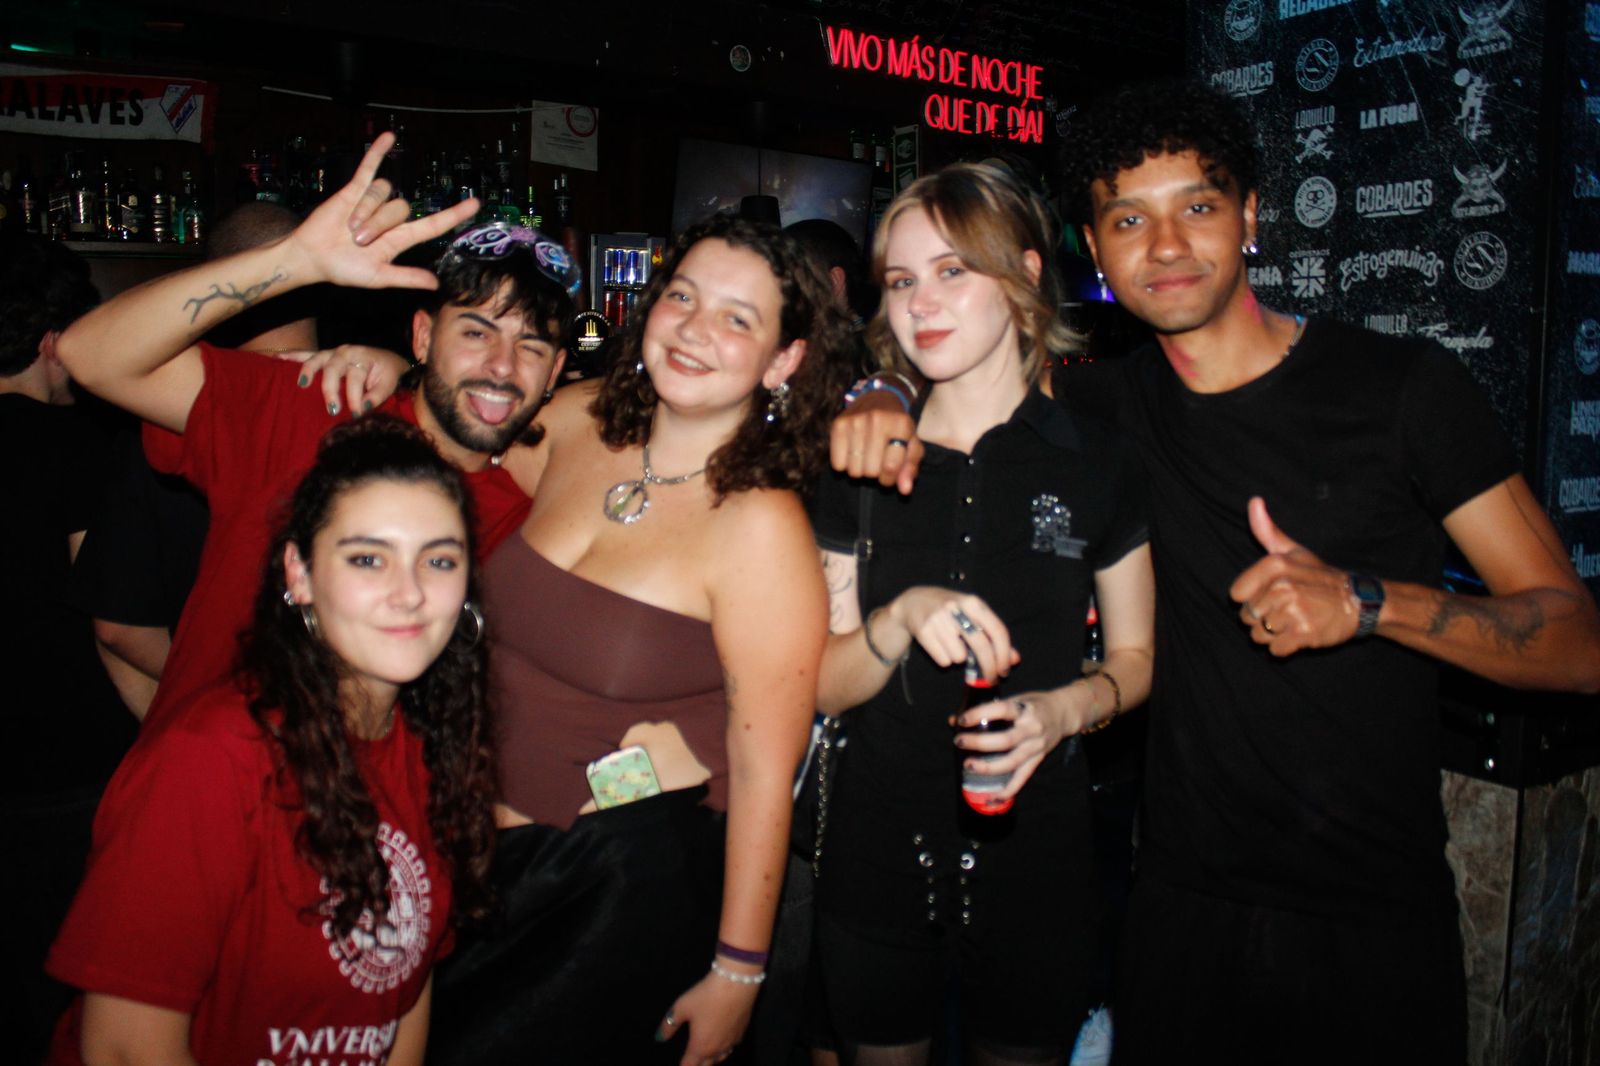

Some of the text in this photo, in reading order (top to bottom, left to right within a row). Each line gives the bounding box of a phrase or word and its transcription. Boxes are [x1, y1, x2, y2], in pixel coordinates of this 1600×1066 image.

[826, 25, 1044, 101] VIVO MÁS DE NOCHE
[0, 79, 144, 126] ALAVES
[925, 93, 973, 134] QUE
[976, 100, 1004, 138] DE
[1007, 99, 1044, 144] DÍA!
[1360, 102, 1419, 130] LA FUGA
[1356, 179, 1434, 215] COBARDES
